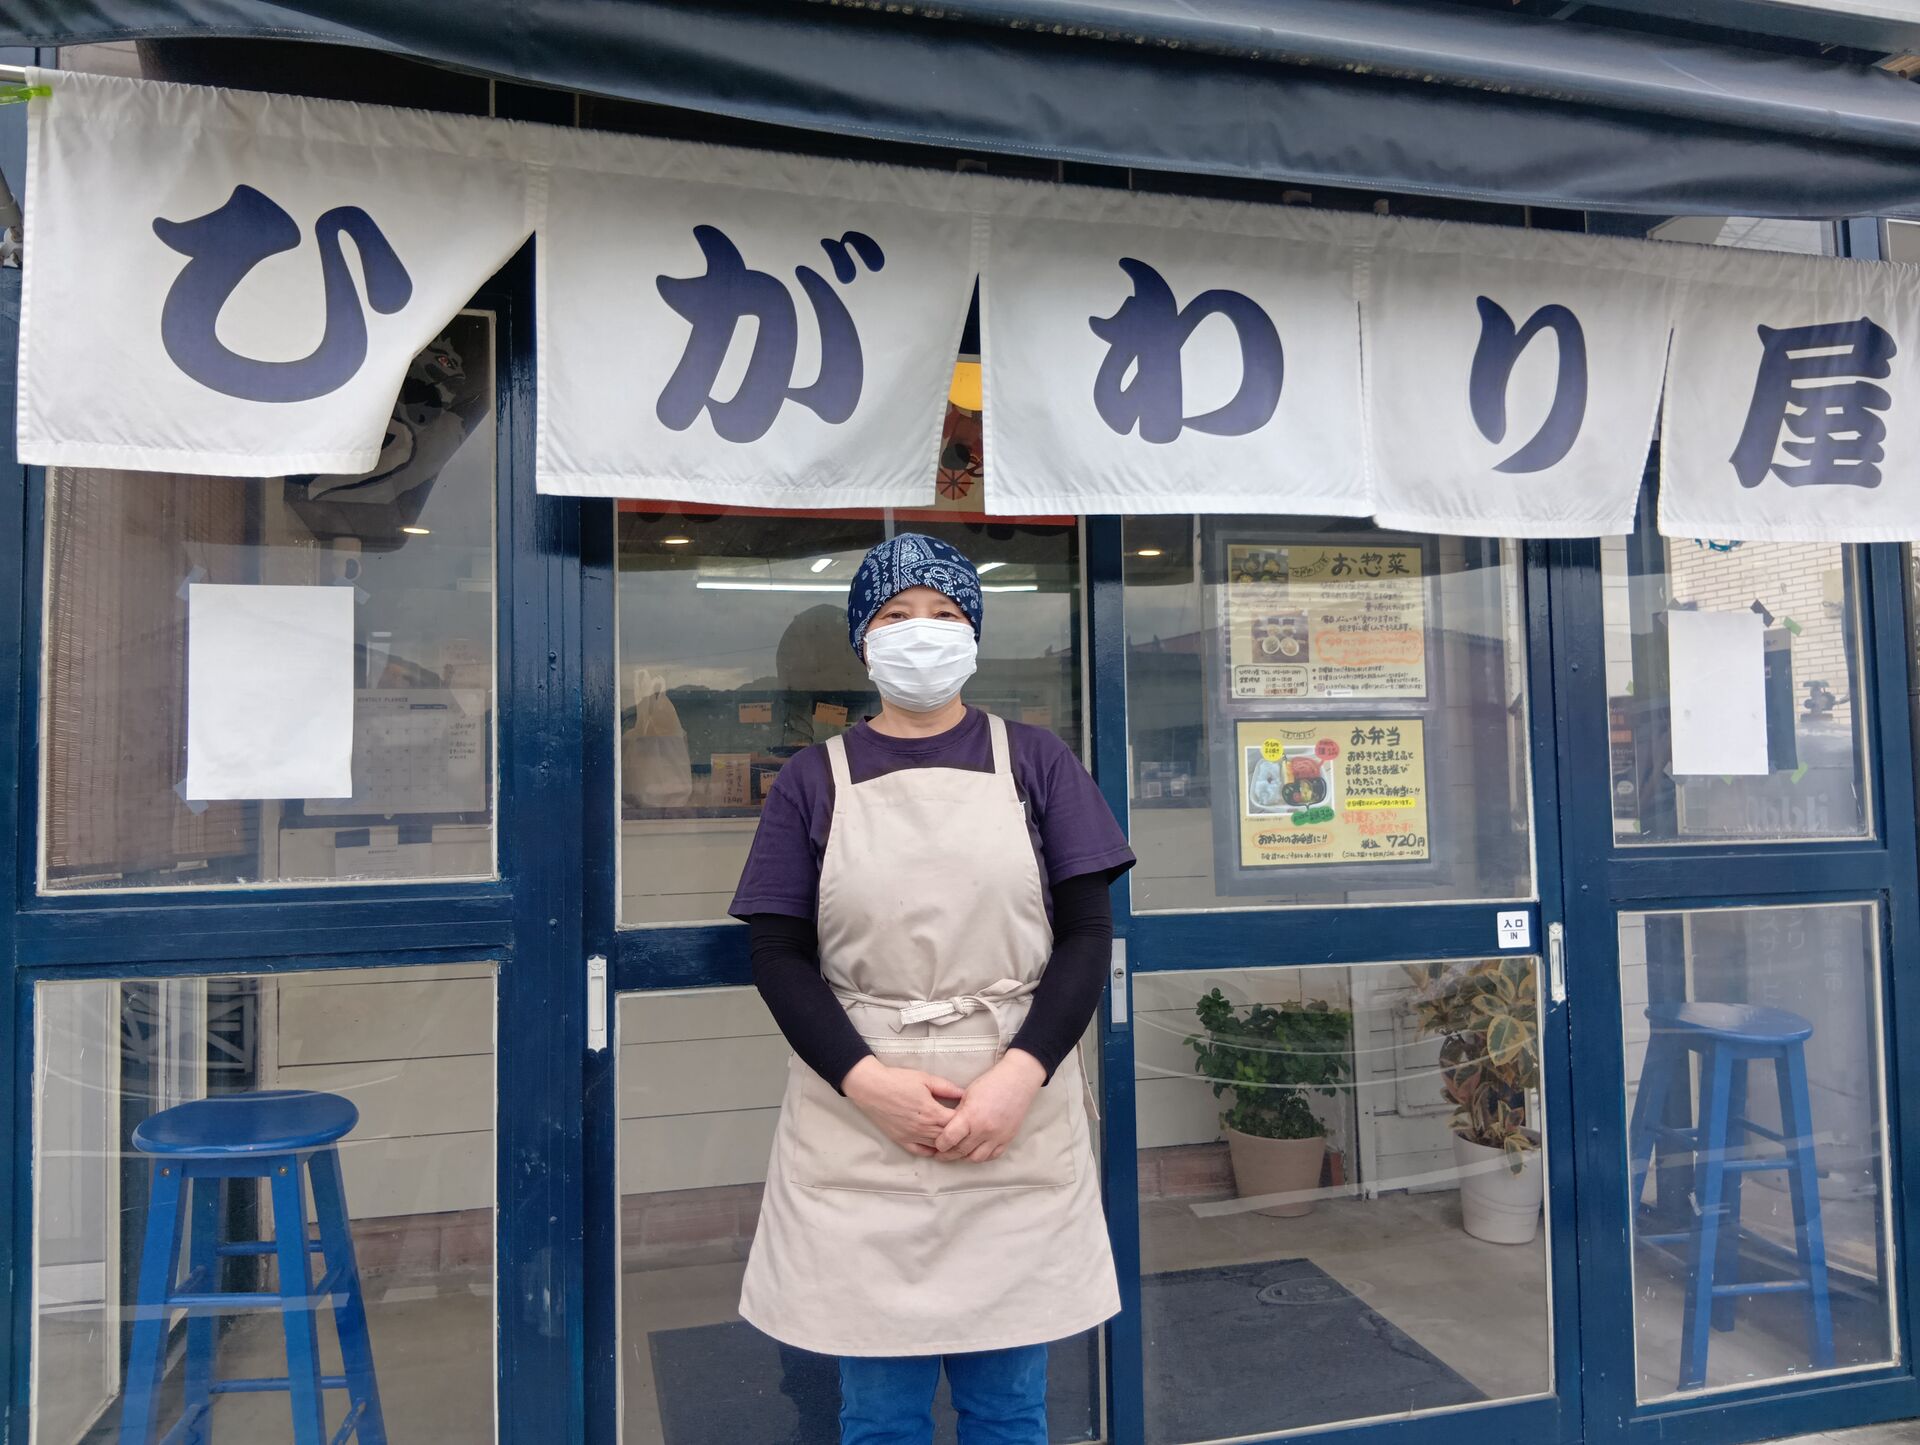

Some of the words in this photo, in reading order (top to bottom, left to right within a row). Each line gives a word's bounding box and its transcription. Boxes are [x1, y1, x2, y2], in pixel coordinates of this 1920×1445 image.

[153, 184, 1897, 489] ひがわり屋
[1330, 551, 1411, 578] お惣菜
[1350, 726, 1401, 747] お弁当
[1386, 834, 1425, 848] 720円
[1503, 919, 1523, 929] 入口
[1510, 932, 1518, 940] IN
